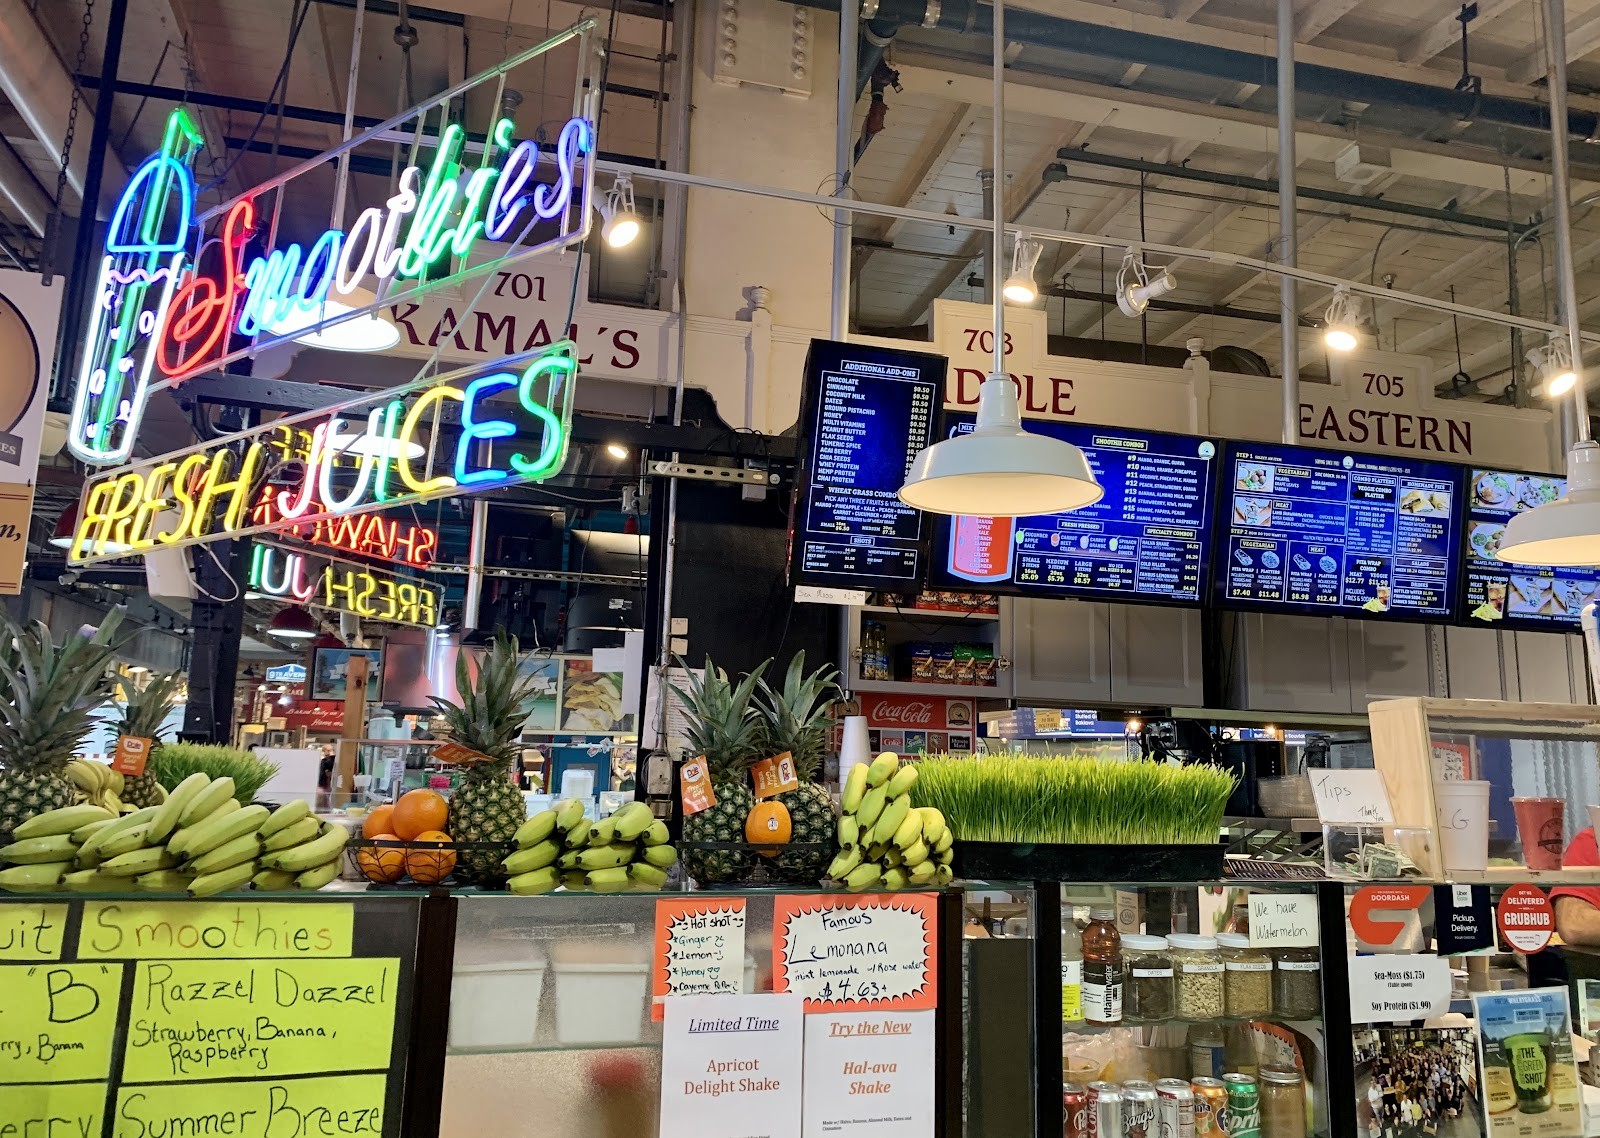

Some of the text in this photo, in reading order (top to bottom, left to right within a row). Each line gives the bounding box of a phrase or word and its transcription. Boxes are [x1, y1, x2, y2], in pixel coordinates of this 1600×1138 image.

[157, 117, 594, 375] Smoothies
[493, 271, 547, 302] 701
[963, 328, 1014, 356] 703
[845, 362, 917, 378] ADDITIONAL ADD-ONS
[827, 375, 859, 385] CHOCOLATE
[1362, 372, 1404, 398] 705
[826, 383, 855, 392] CINNAMON
[913, 386, 930, 394] $0.50
[825, 390, 851, 399] COCONUT
[912, 393, 929, 401] $0.50
[825, 397, 843, 405] DATES
[823, 411, 842, 419] HONEY
[824, 404, 876, 416] GROUND PISTACHIO
[822, 418, 866, 428] MULTI VITAMINS
[822, 425, 866, 436] PEANUT BUTTER
[1299, 403, 1473, 456] EASTERN
[821, 432, 854, 442] FLAX SEEDS
[820, 439, 862, 450] TUMERIC SPICE
[819, 446, 852, 456] ACAI BERRY
[71, 355, 575, 561] FRESH JUICES
[819, 453, 851, 463] CHIA SEEDS
[817, 467, 834, 475] HEMP
[818, 460, 860, 470] WHEY PROTEIN
[817, 474, 855, 484] CHAI PROTEIN
[828, 486, 874, 497] WHEAT GRASS
[1232, 588, 1251, 596] $7.40
[1316, 774, 1352, 803] Tips
[1507, 897, 1546, 905] DELIVERED
[1253, 900, 1299, 918] We have
[1452, 913, 1476, 923] Pickup.
[1504, 912, 1550, 926] GRUBHUB
[91, 904, 335, 953] Smoothies
[1255, 922, 1309, 940] Watermelon
[1451, 923, 1478, 933] Delivery.
[788, 934, 889, 965] Lemonana
[681, 967, 706, 978] Honey
[819, 964, 860, 978] lemonade
[1374, 970, 1425, 980] Sea-Moss ($1.75)
[145, 963, 388, 1015] Razzel Dazzel
[1371, 1000, 1432, 1012] Soy Protein ($1.99)
[688, 1016, 780, 1033] Limited Time
[829, 1020, 912, 1038] Try the New
[132, 1019, 252, 1049] Strawberry,
[168, 1042, 270, 1075] Raspberry
[1520, 1046, 1536, 1059] THE
[706, 1058, 760, 1076] Apricot
[842, 1061, 898, 1075] Hal-ava
[1522, 1060, 1544, 1071] GREEN
[1524, 1072, 1543, 1085] SHOT
[684, 1077, 780, 1097] Delight Shake
[848, 1081, 892, 1095] Shake
[119, 1085, 384, 1138] Summer Breeze
